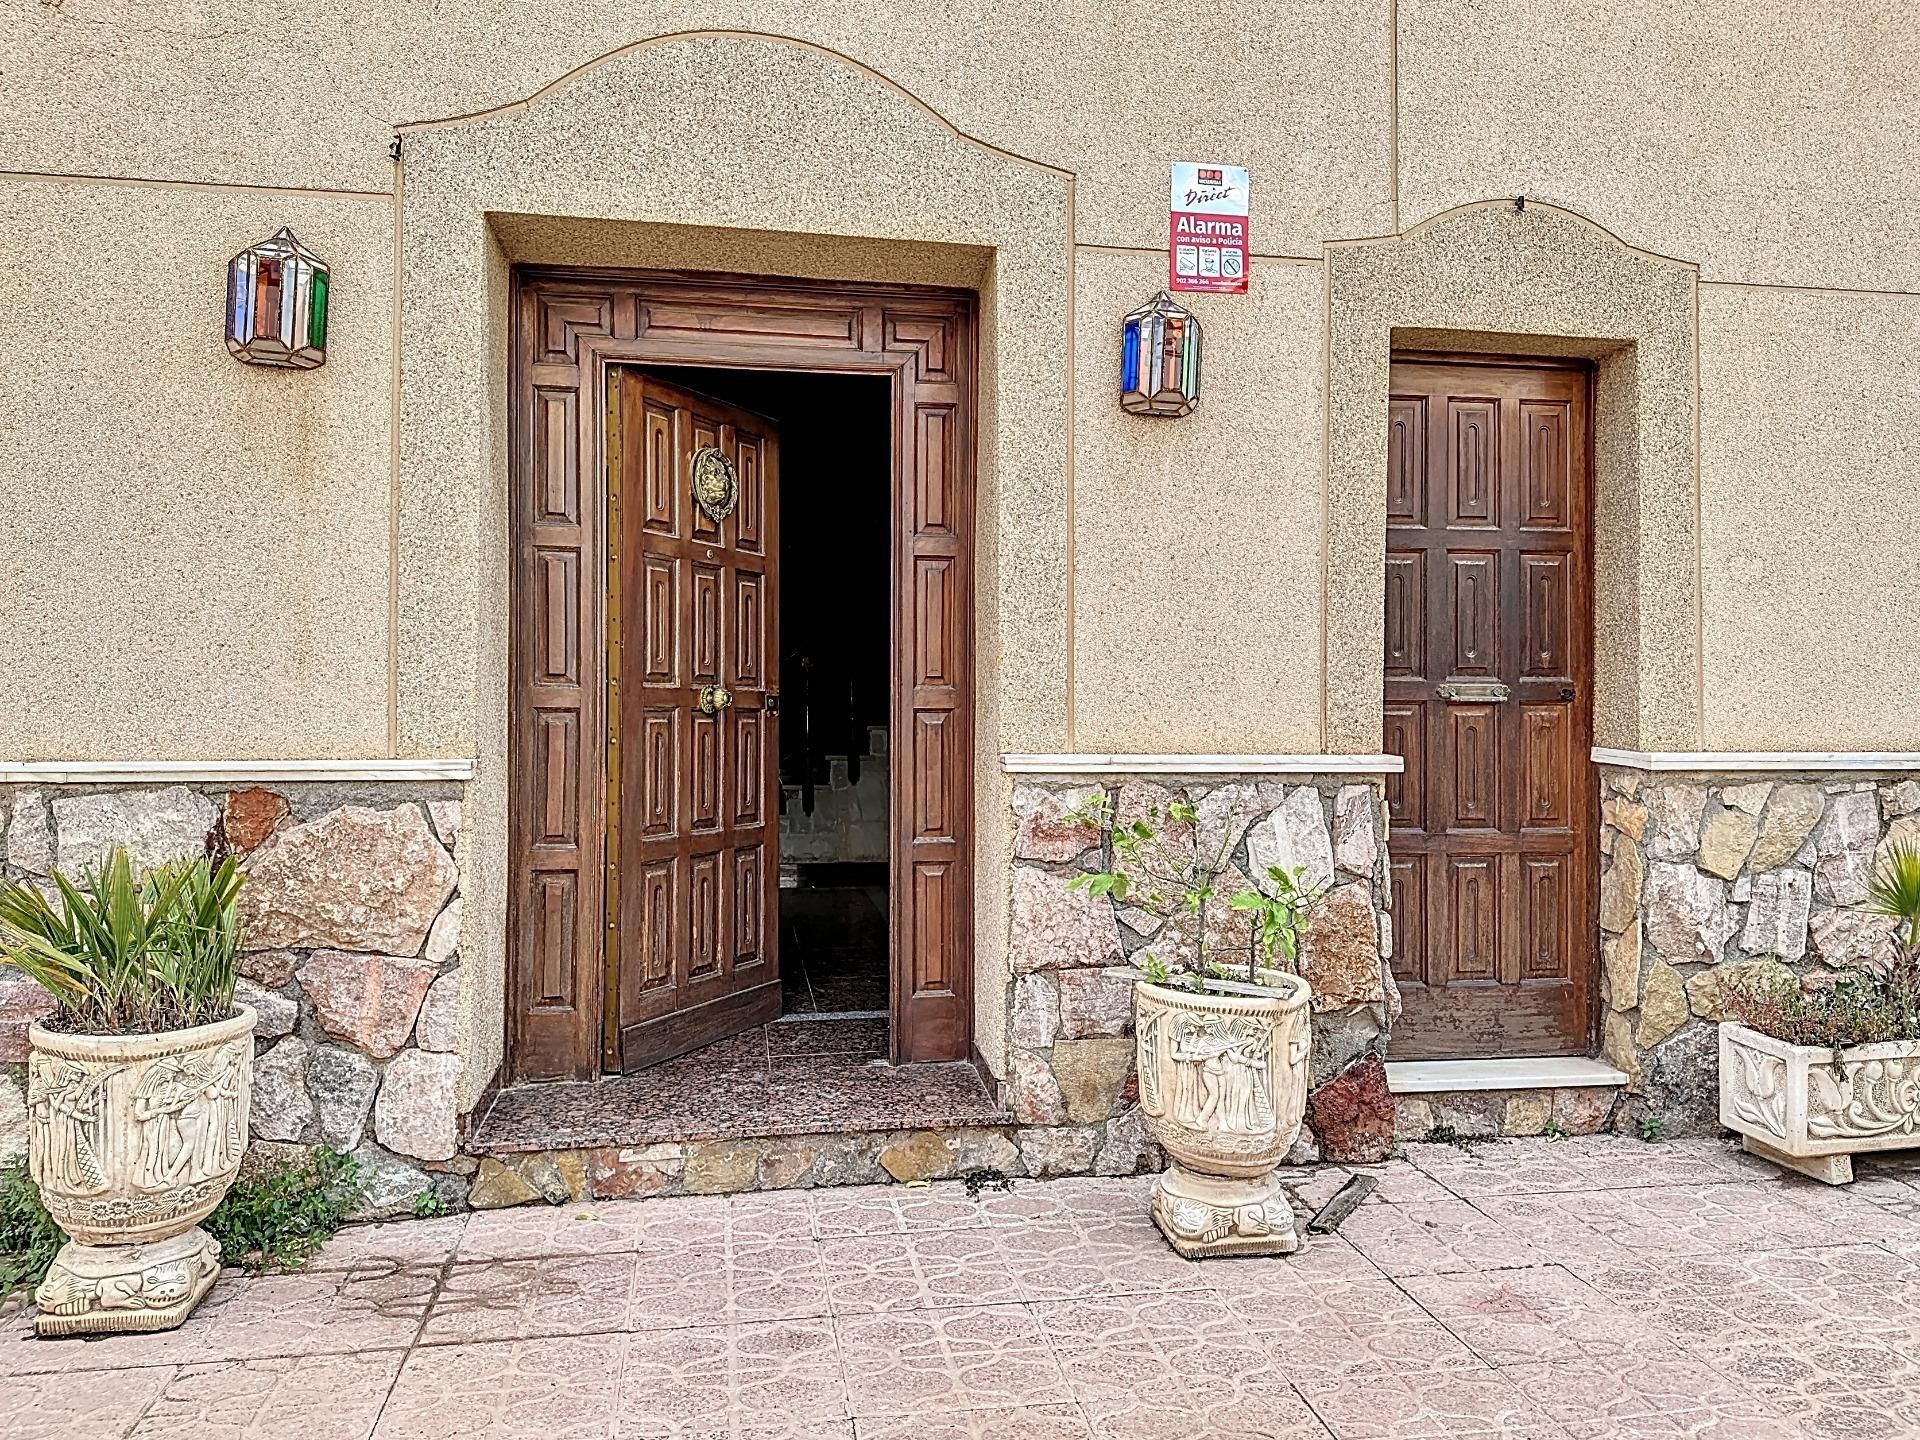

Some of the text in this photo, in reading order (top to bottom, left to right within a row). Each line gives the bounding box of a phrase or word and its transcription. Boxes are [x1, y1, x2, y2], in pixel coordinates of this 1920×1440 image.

[1184, 186, 1236, 206] Direct
[1176, 216, 1243, 236] Alarma
[1176, 235, 1190, 243] con
[1191, 235, 1211, 244] aviso
